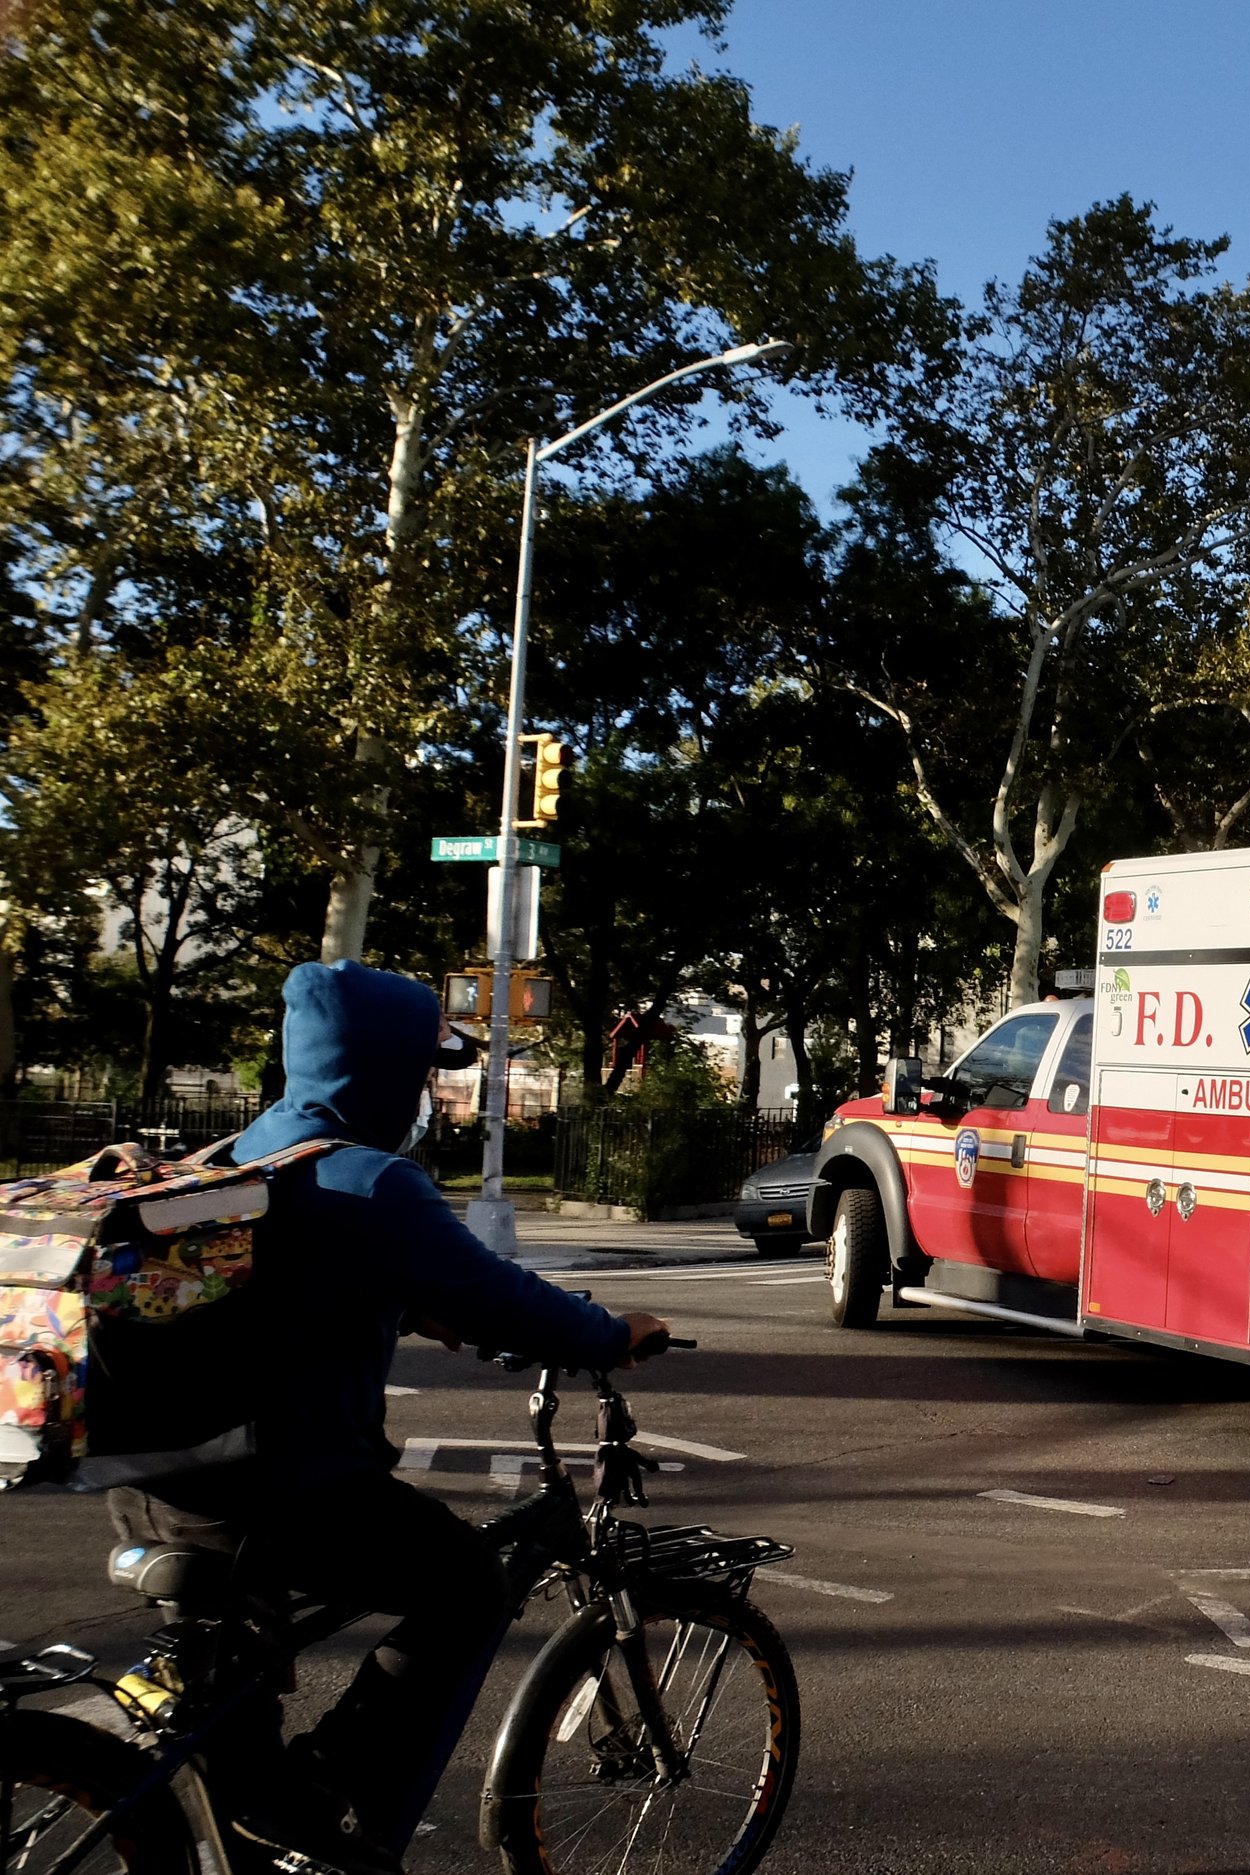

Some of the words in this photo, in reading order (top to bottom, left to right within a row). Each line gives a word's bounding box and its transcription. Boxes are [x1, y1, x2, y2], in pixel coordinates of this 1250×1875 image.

[439, 840, 482, 860] Degraw
[528, 843, 535, 860] 3
[1105, 928, 1132, 950] 522
[1100, 982, 1124, 993] FDNY
[1110, 993, 1133, 1004] green
[1134, 991, 1213, 1048] F.D.
